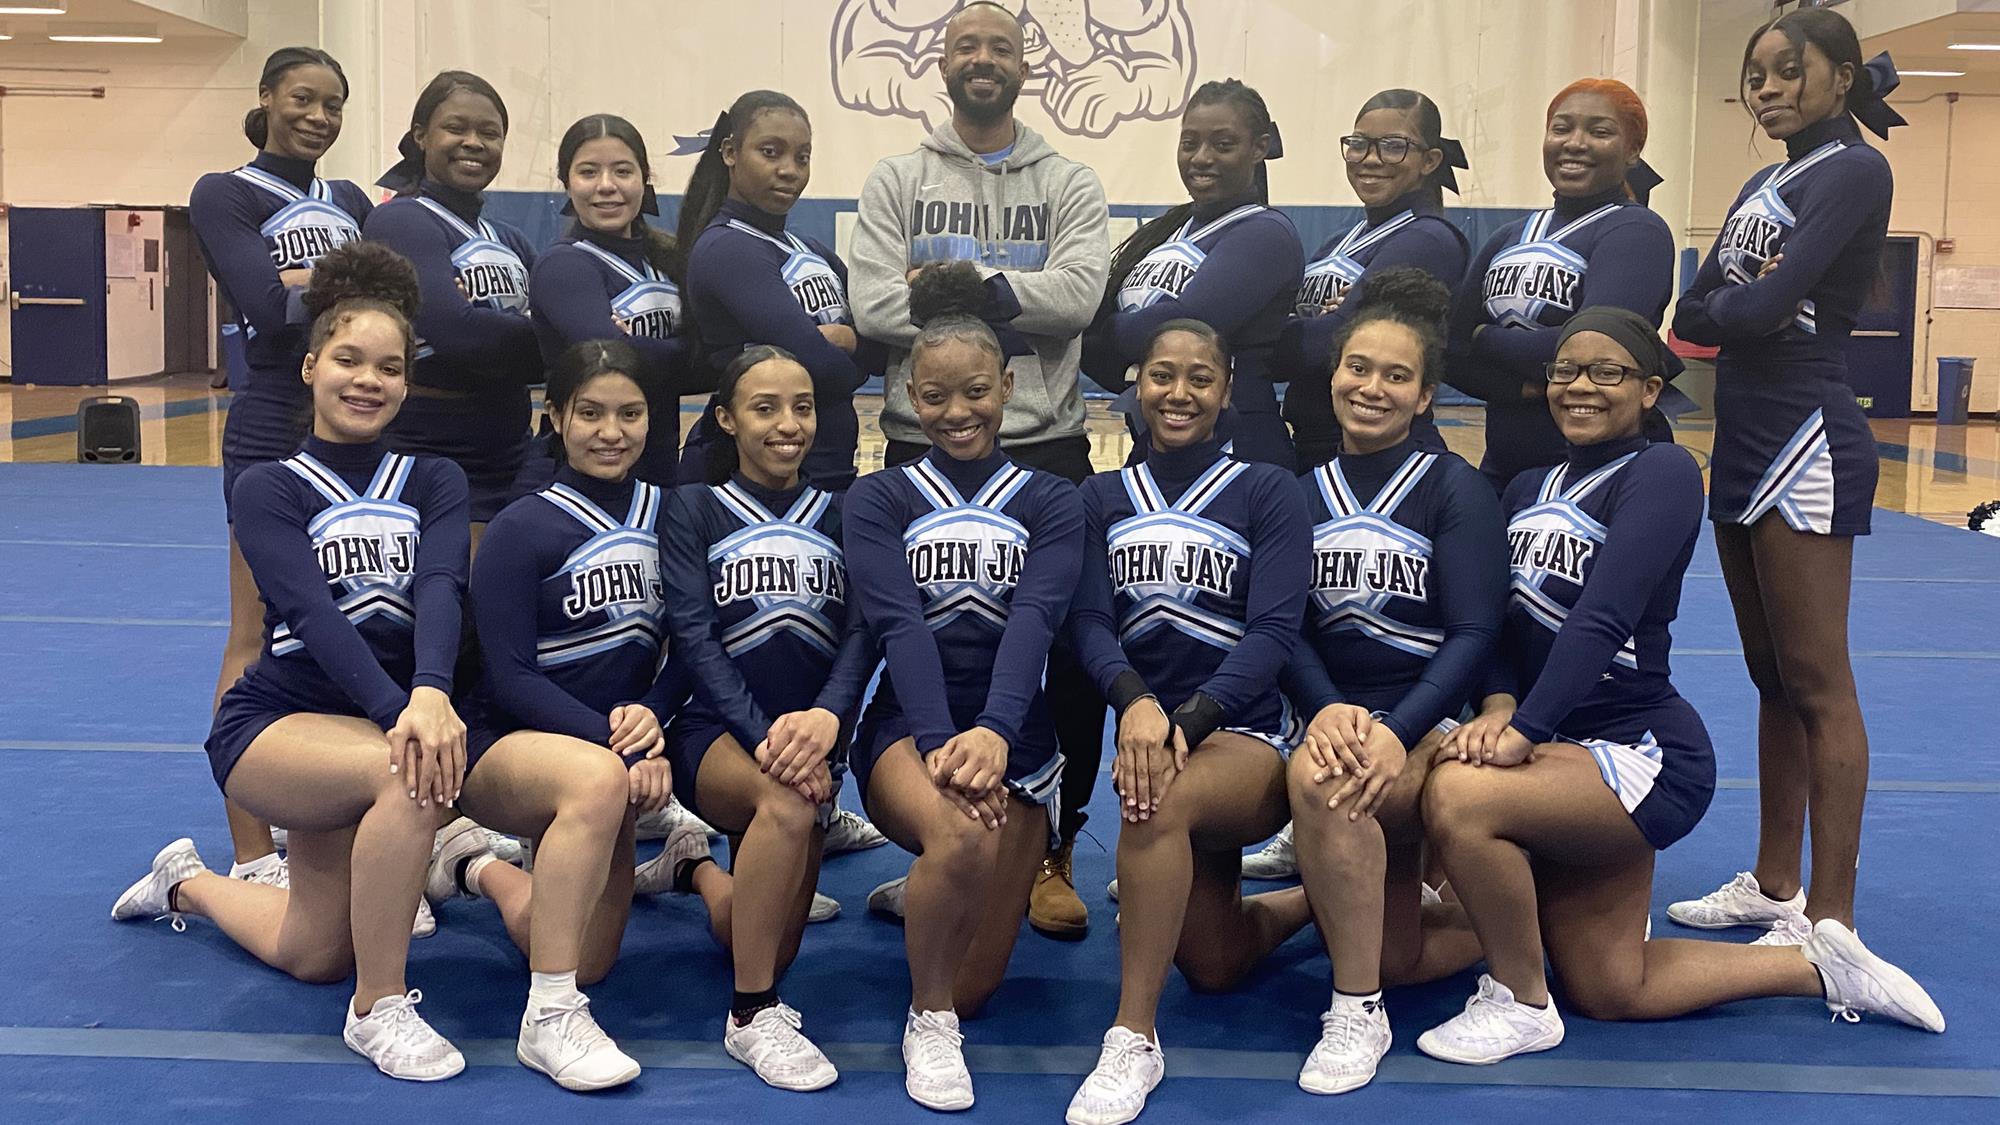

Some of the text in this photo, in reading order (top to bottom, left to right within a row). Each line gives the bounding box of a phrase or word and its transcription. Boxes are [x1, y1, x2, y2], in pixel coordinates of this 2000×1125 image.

[912, 199, 1048, 241] JOHN JAY
[1736, 215, 1778, 259] JAY
[271, 226, 335, 267] JOHN
[1151, 260, 1197, 295] JAY
[1525, 264, 1577, 306] JAY
[623, 309, 672, 338] OHN
[1174, 544, 1235, 594] JAY
[1367, 551, 1426, 598] JAY
[1534, 532, 1591, 580] JAY
[567, 562, 645, 616] JOHN
[716, 556, 797, 603] JOHN
